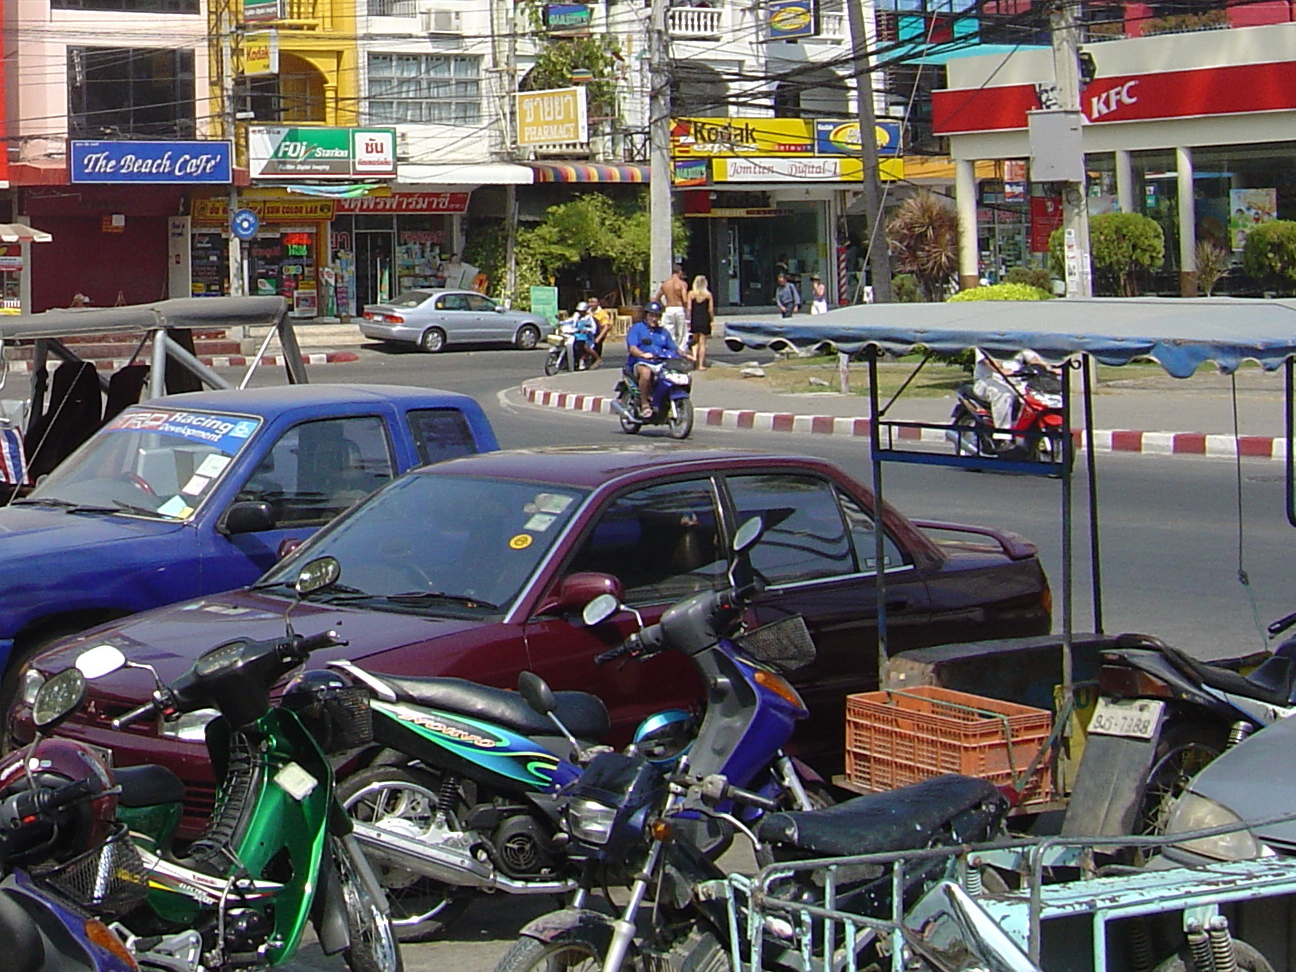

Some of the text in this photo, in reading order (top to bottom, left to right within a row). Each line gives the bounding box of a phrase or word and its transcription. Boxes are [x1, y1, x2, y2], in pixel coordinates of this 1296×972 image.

[246, 45, 270, 62] Kodak
[1090, 80, 1137, 119] KFC
[524, 123, 575, 141] PHARMACY
[692, 121, 756, 143] Kodak
[315, 146, 348, 158] Station
[83, 151, 117, 174] The
[120, 151, 172, 174] Beach
[282, 204, 304, 215] COLOR
[158, 423, 223, 442] Development
[169, 412, 234, 434] Racing
